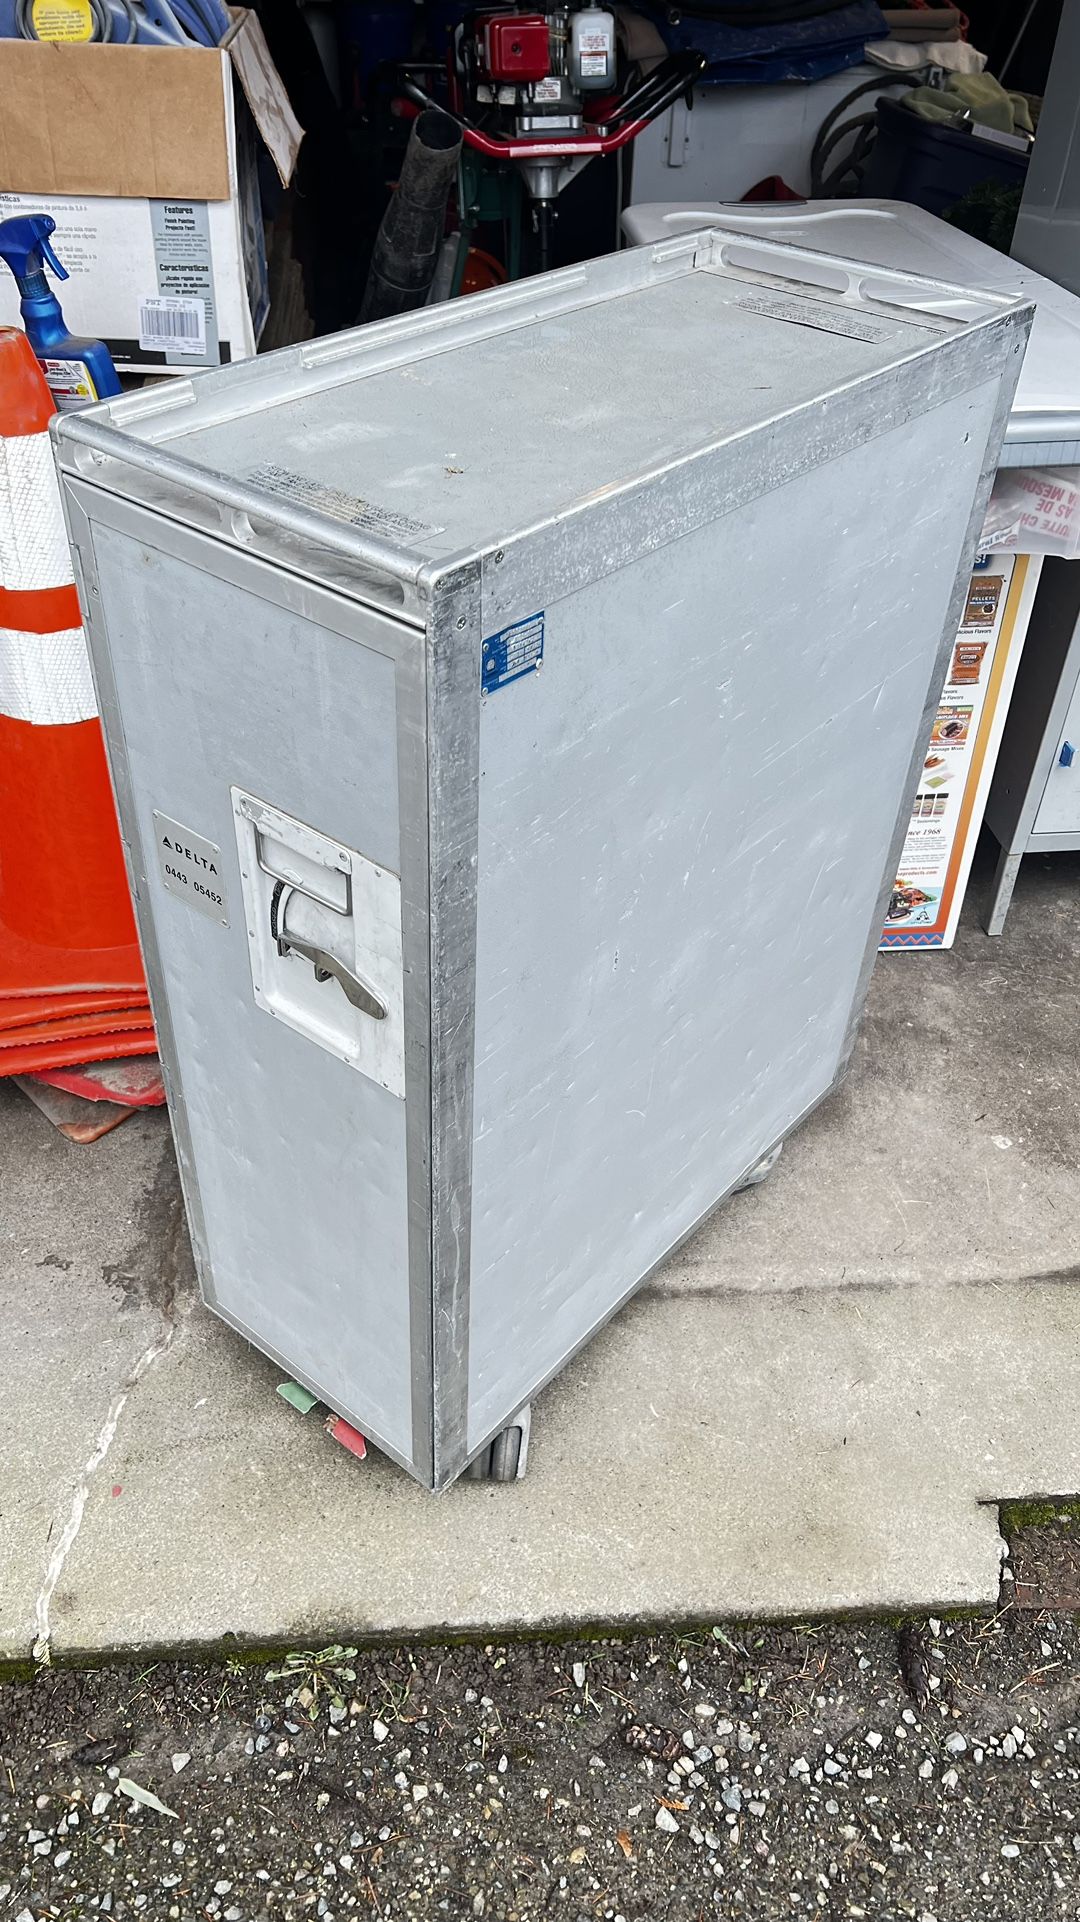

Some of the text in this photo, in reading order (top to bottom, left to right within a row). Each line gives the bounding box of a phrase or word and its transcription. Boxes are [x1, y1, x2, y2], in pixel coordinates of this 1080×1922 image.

[164, 205, 194, 214] Features
[1035, 498, 1055, 514] DE
[922, 828, 942, 836] 1968
[175, 842, 218, 876] DELTA
[165, 864, 223, 906] 0443 05452
